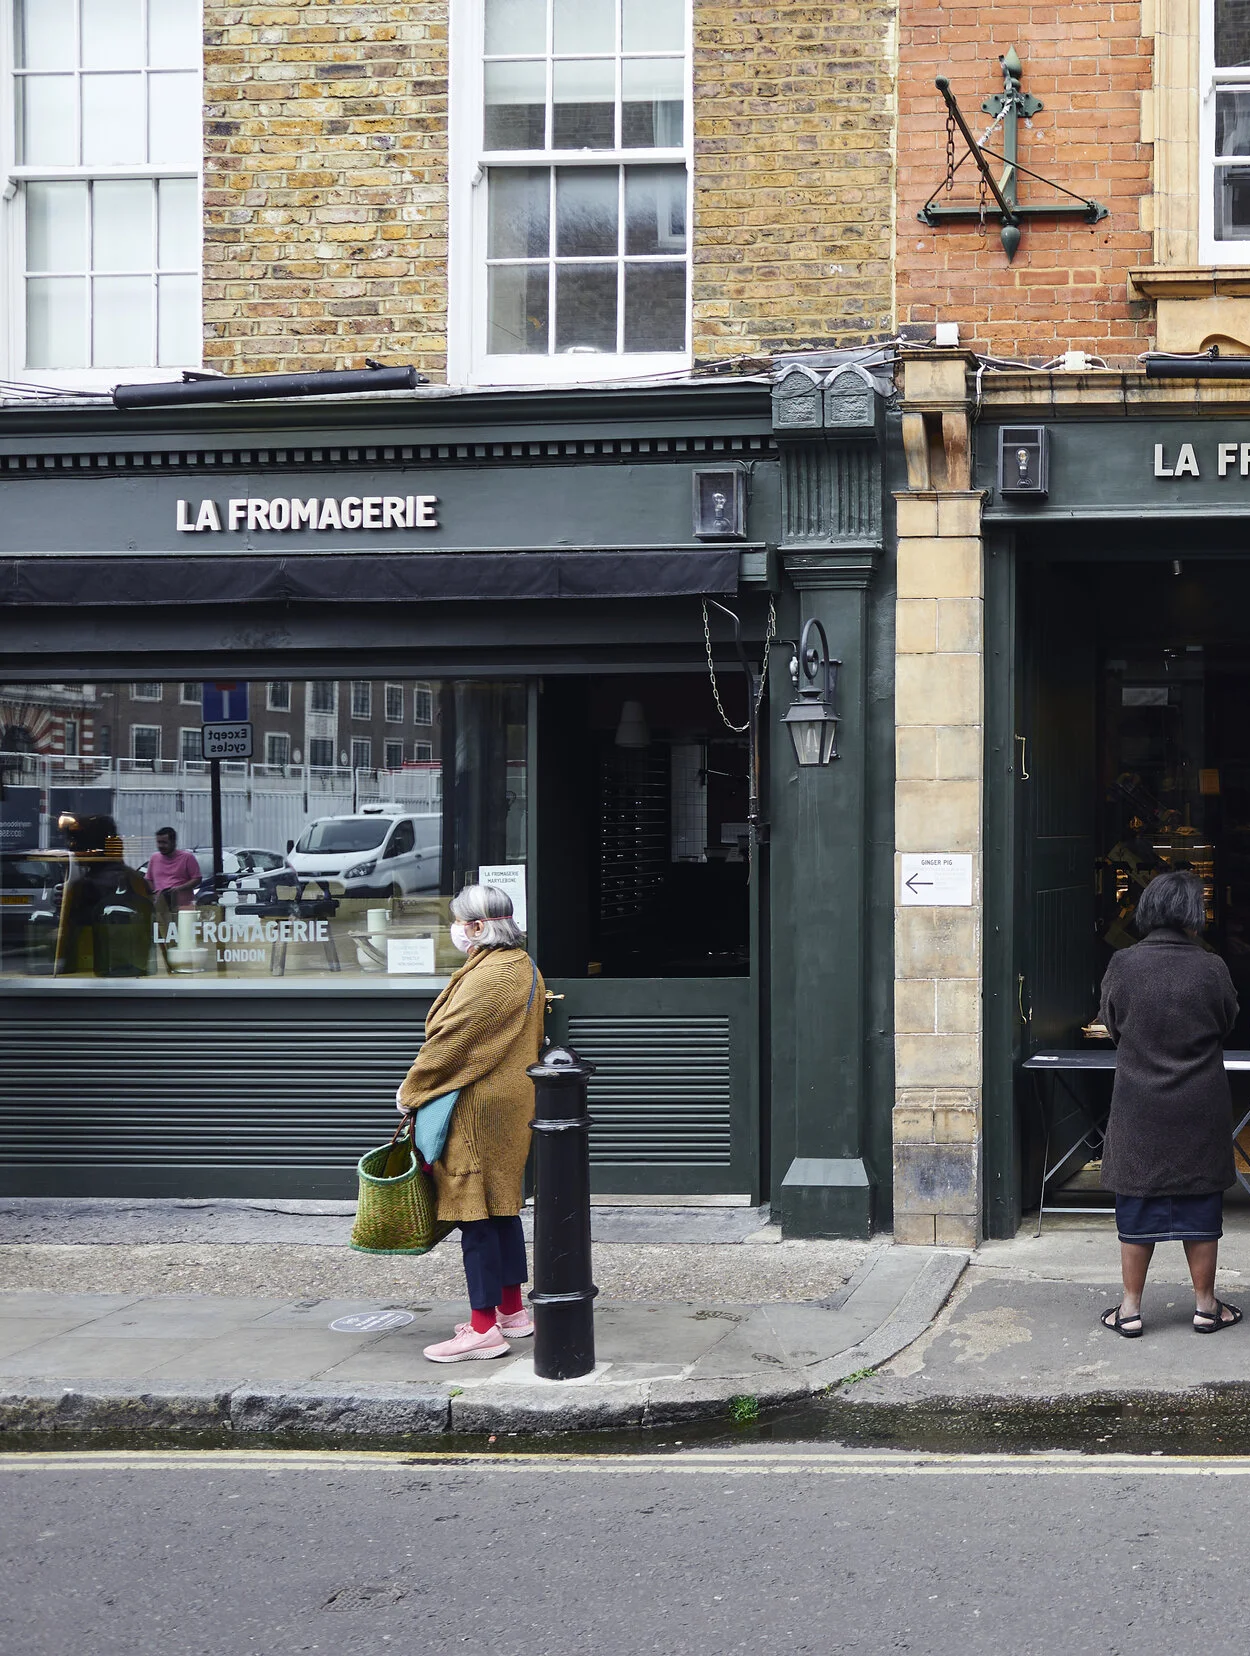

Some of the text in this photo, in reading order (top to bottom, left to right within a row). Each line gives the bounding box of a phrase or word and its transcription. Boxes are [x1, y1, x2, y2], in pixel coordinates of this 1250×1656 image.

[1154, 442, 1200, 477] LA
[176, 495, 438, 532] LA FROMAGERIE
[153, 920, 329, 943] LA FROMAGERIE
[216, 949, 266, 963] LONDON
